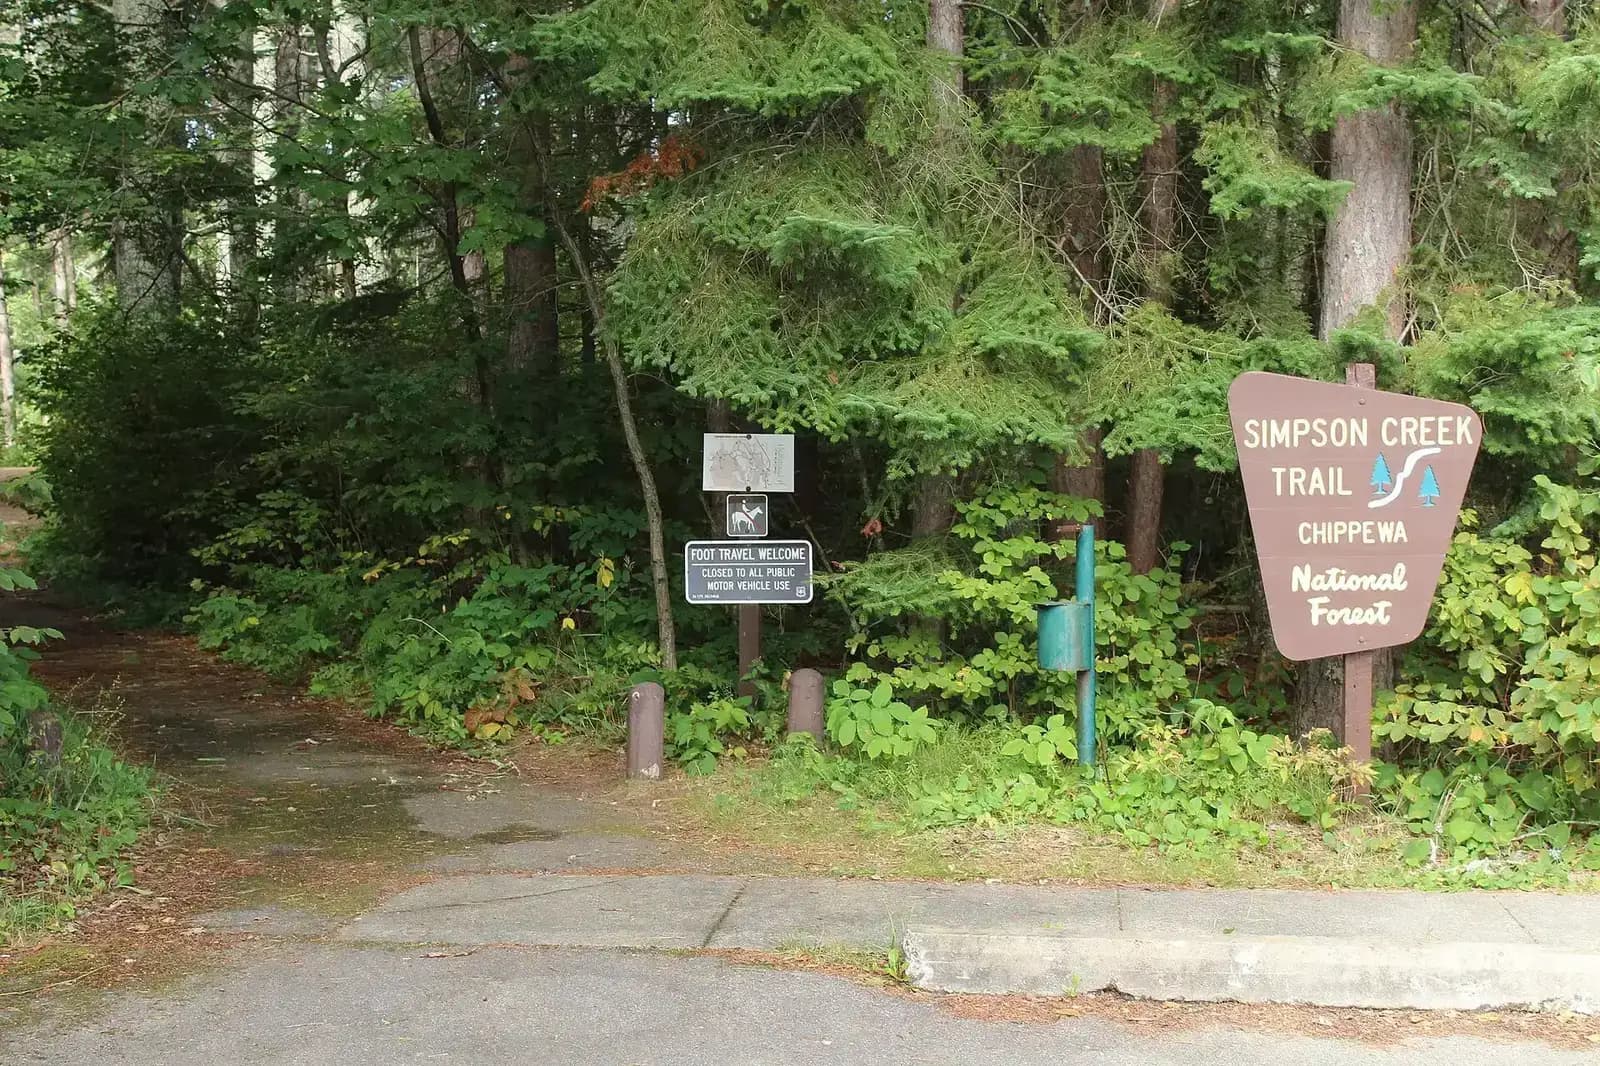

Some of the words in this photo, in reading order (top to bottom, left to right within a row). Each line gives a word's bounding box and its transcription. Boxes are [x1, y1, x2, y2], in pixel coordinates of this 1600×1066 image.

[1243, 418, 1367, 448] SIMPSON
[1381, 416, 1473, 446] CREEK
[1271, 467, 1352, 496] TRAIL
[1298, 521, 1408, 544] CHIPPEWA
[691, 548, 715, 560] FOOT
[719, 548, 755, 560] TRAVEL
[758, 548, 805, 560] WELCOME
[702, 568, 733, 578] CLOSED
[736, 568, 746, 577] TO
[749, 568, 763, 577] ALL
[766, 568, 795, 577] PUBLIC
[708, 581, 734, 590] MOTOR
[737, 581, 770, 590] VEHICLE
[774, 581, 790, 590] USE
[1291, 562, 1408, 592] National
[1307, 596, 1392, 626] Forest
